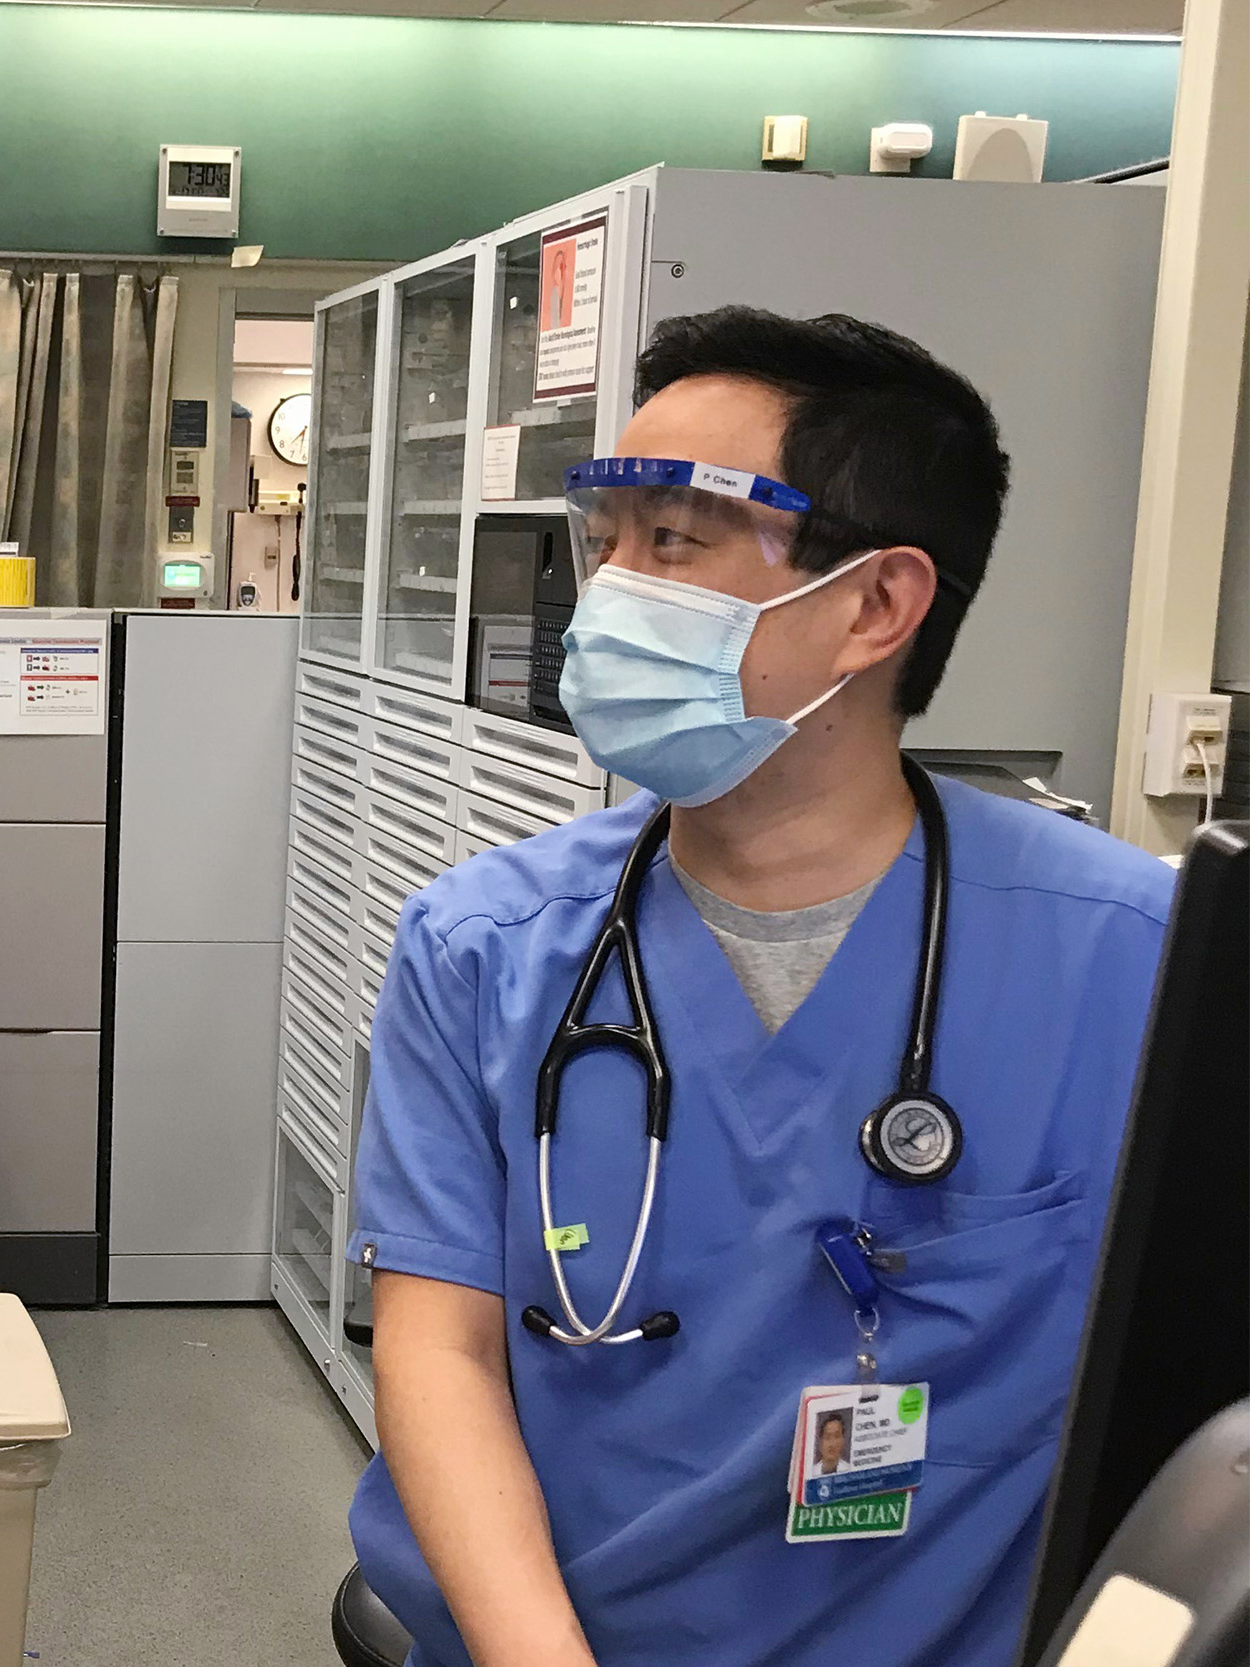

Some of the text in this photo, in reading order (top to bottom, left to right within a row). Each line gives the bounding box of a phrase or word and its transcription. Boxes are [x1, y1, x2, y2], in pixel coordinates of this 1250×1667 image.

[713, 475, 737, 487] Chen
[856, 1408, 875, 1416] PAUL
[797, 1502, 904, 1529] PHYSICIAN
